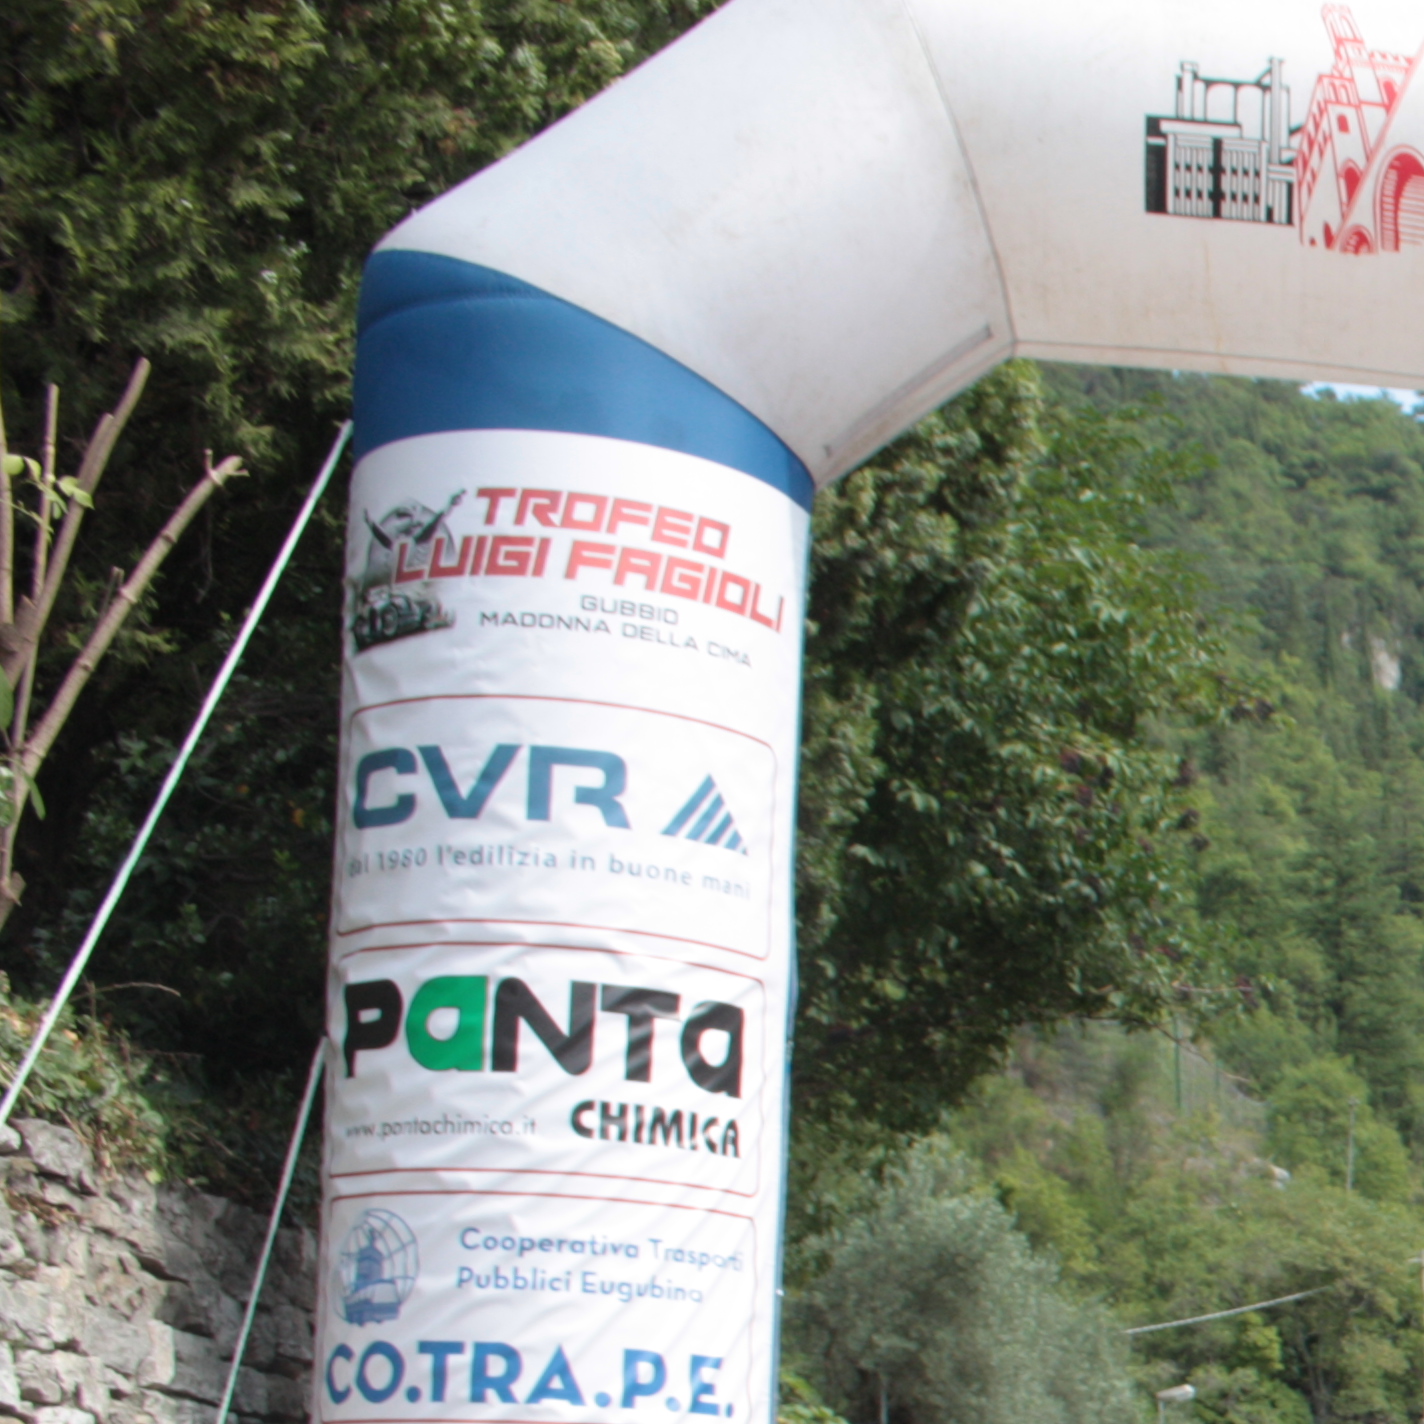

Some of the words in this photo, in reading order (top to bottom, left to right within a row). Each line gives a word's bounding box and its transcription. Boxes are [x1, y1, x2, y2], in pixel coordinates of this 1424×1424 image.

[477, 487, 731, 559] TROFEO
[394, 535, 551, 584] LUIGI
[565, 539, 785, 633] FAGIOLI
[581, 595, 678, 624] GUBBIO
[480, 611, 611, 634] MADONNA
[622, 622, 698, 651] DELLA
[707, 641, 752, 668] CIMA
[352, 744, 632, 830] CVR
[378, 847, 427, 870] 1980
[437, 845, 557, 867] l'edilizia
[569, 849, 596, 870] in
[608, 853, 692, 886] buone
[702, 874, 750, 899] mani
[570, 1100, 742, 1158] CHIMICA
[459, 1227, 639, 1260] Cooperativa
[648, 1238, 745, 1272] Trasporti
[456, 1266, 572, 1294] Pubblici
[580, 1271, 702, 1303] Eugubina
[325, 1340, 734, 1419] CO.TRA.P.E.
